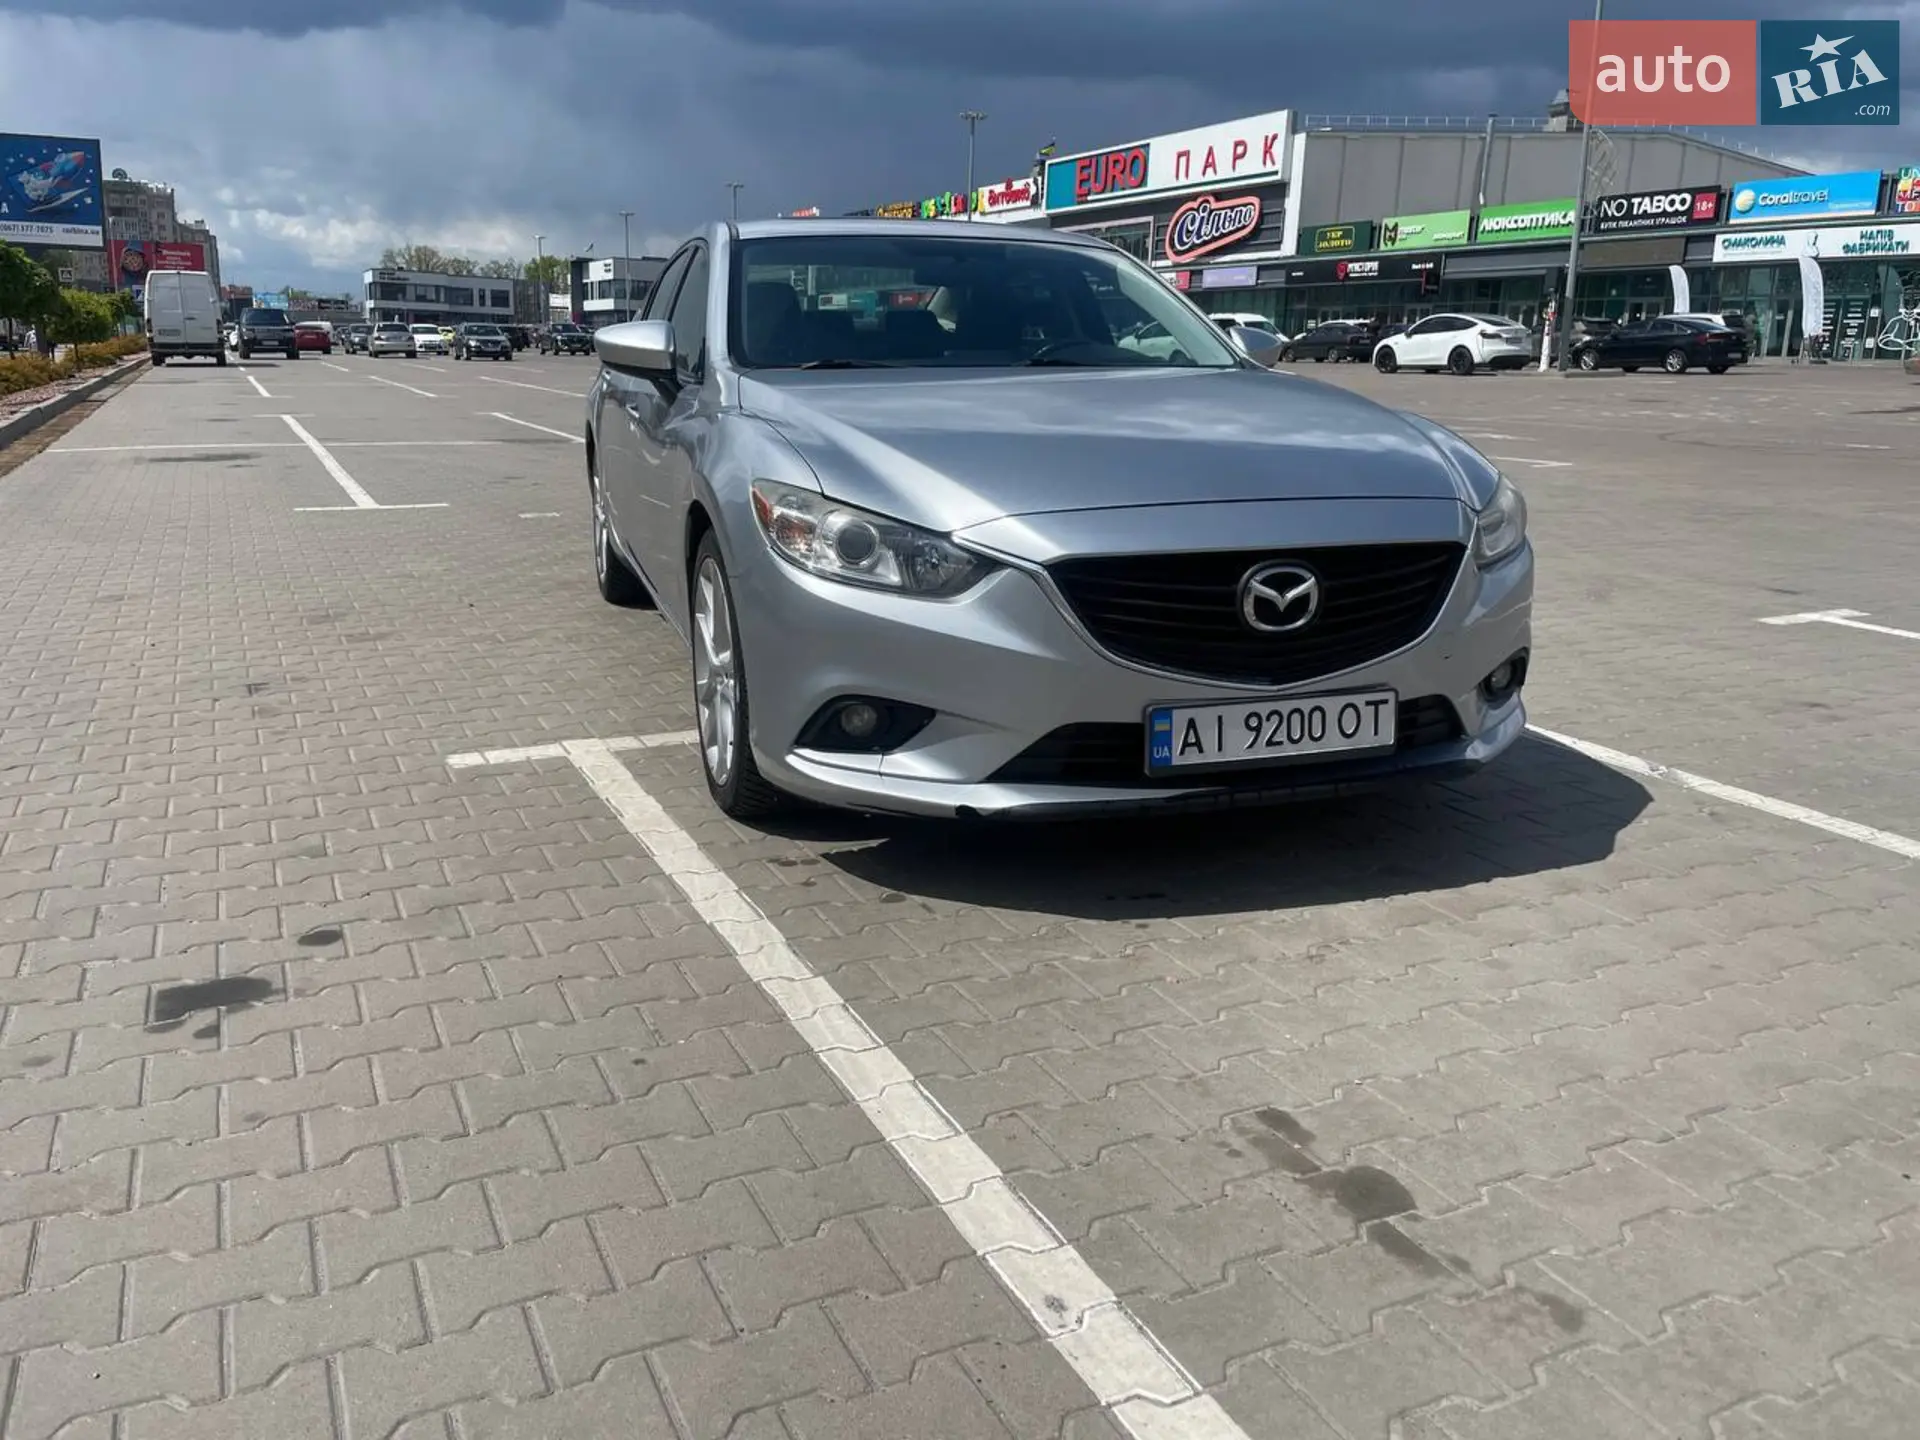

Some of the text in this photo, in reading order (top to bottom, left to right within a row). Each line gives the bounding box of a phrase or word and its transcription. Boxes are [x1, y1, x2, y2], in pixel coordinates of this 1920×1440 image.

[1075, 147, 1147, 197] EURO
[1175, 133, 1279, 181] ПАРК
[1600, 193, 1692, 218] NO TABOO
[1695, 200, 1714, 212] 18+
[1174, 203, 1256, 251] Сільпо
[1480, 209, 1576, 233] ЛЮКСОПТИКА
[1842, 240, 1910, 254] ФАБРИКАТИ
[1859, 230, 1894, 241] НАПІВ
[1178, 699, 1389, 756] AI 9200 OT
[1154, 746, 1170, 758] UA
